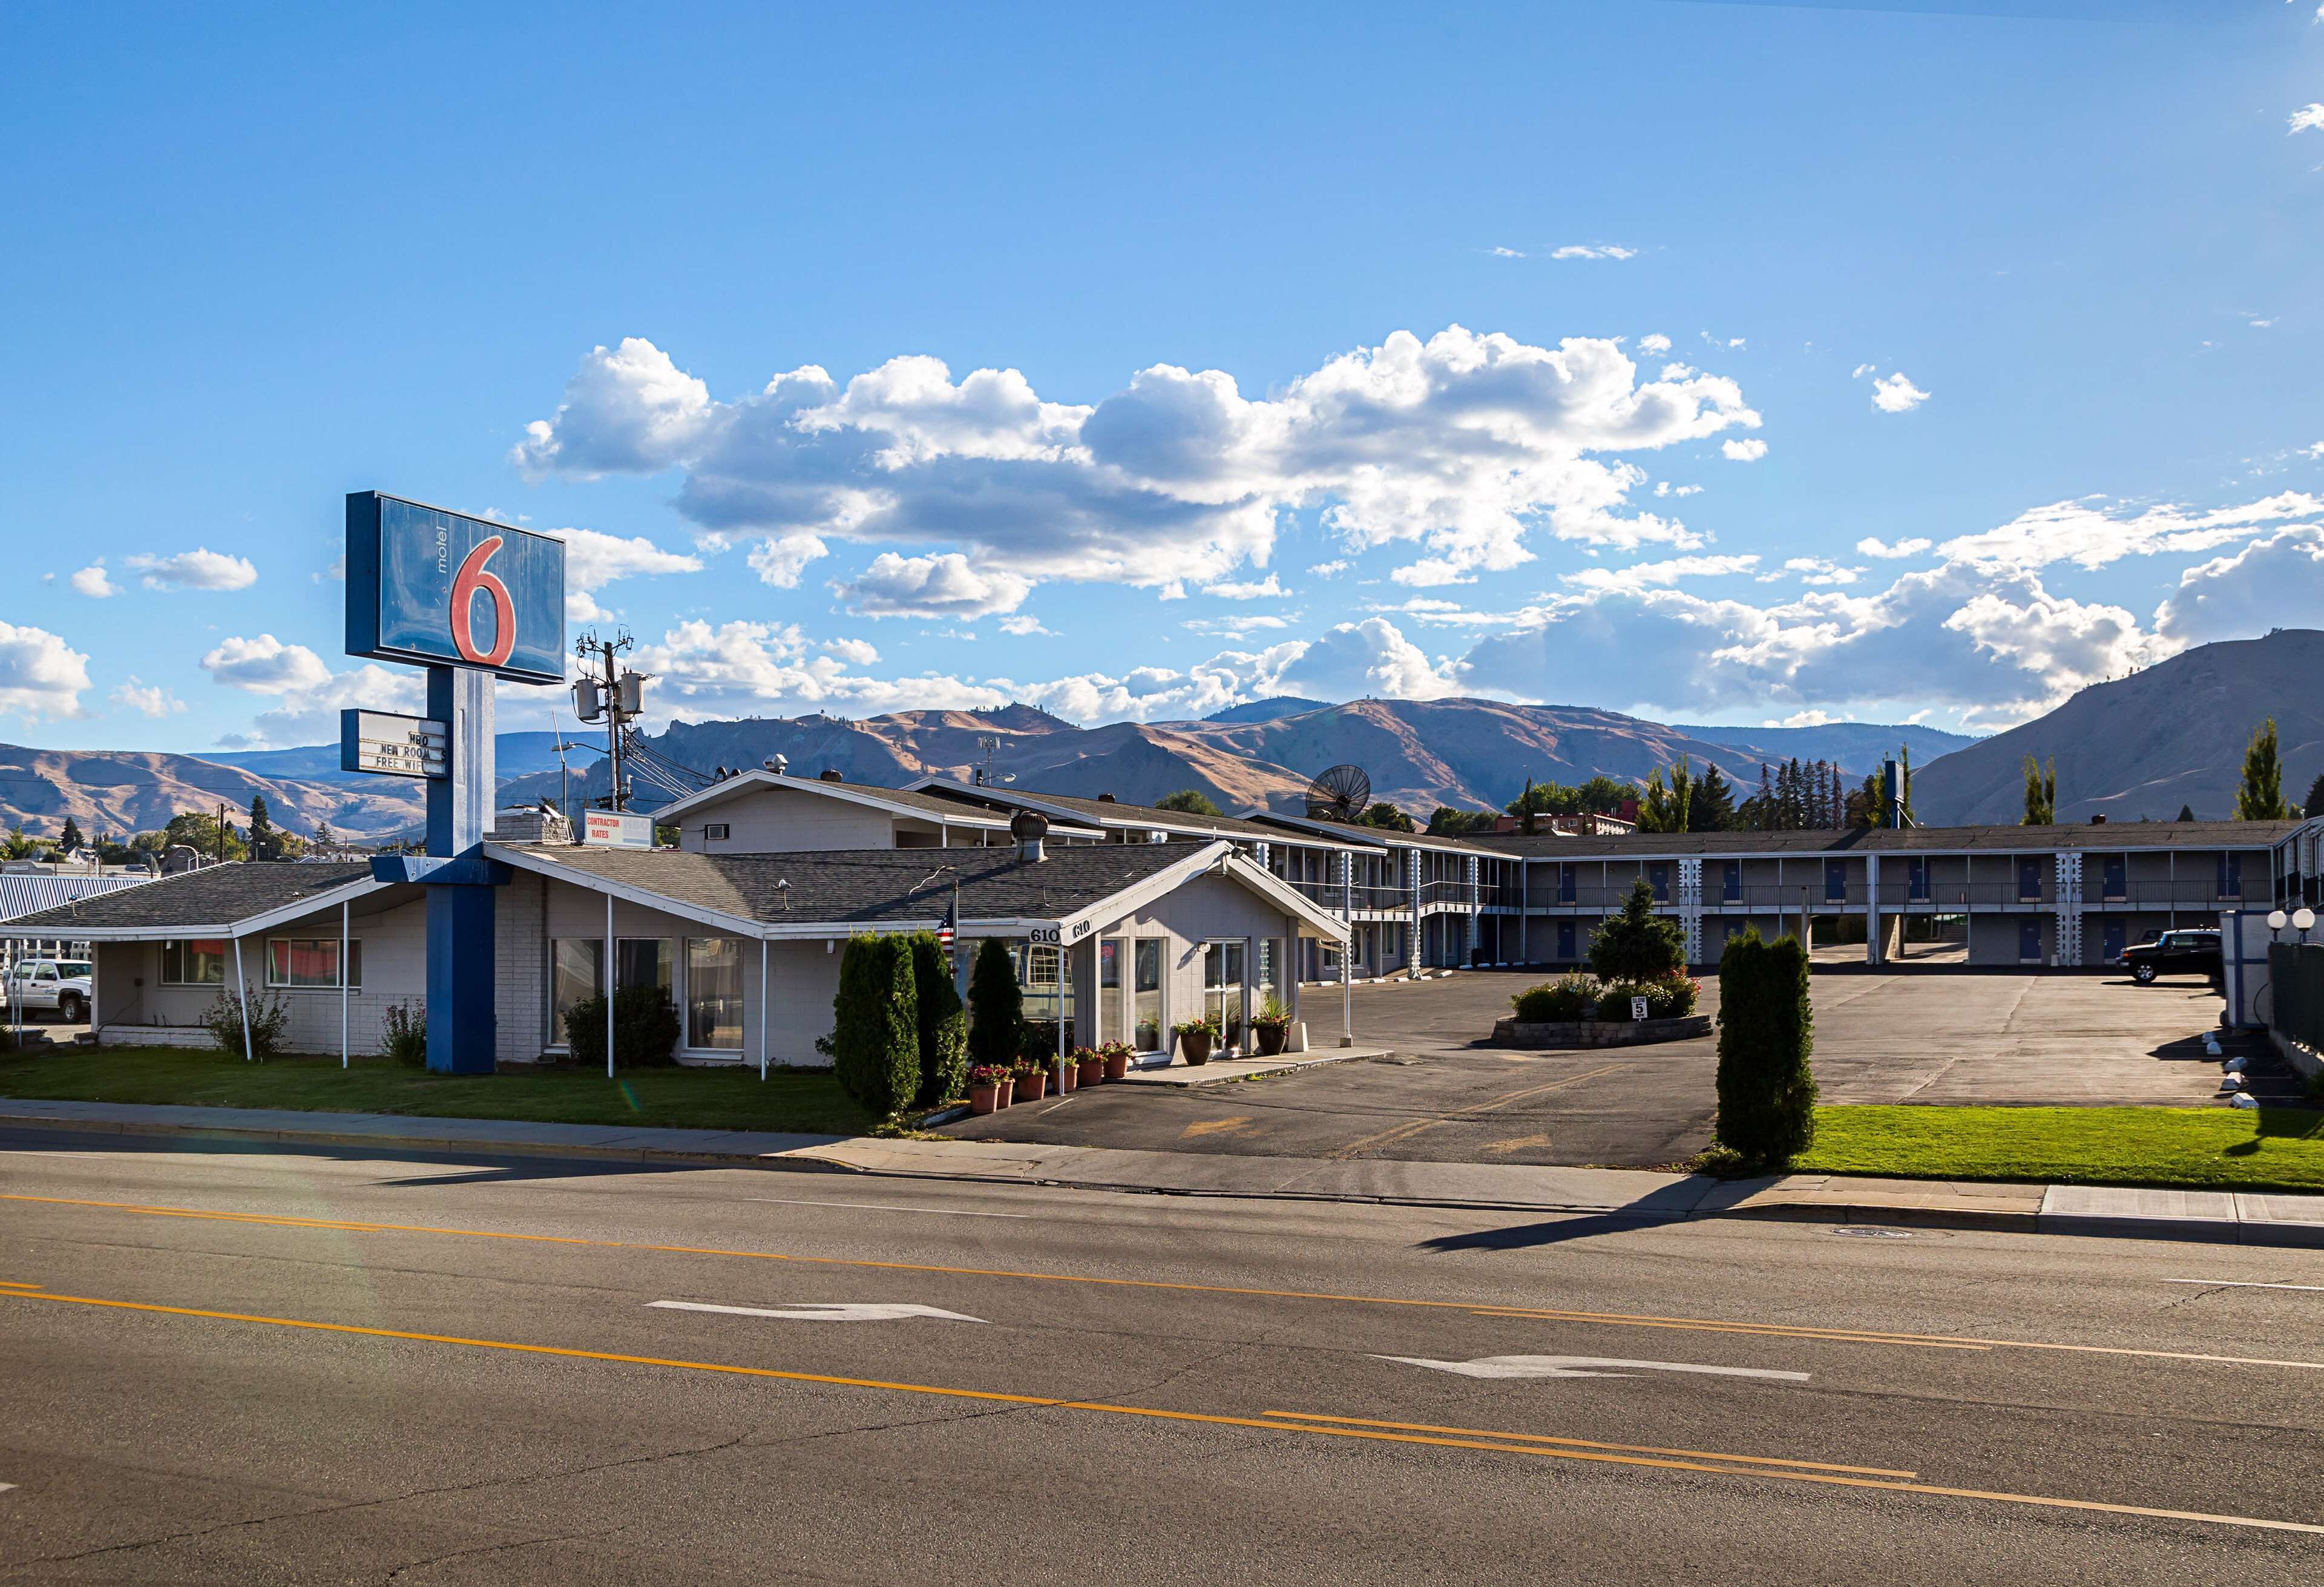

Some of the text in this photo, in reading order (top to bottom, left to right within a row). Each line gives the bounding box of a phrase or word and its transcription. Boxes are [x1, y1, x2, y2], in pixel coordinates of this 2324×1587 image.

[436, 526, 447, 574] motel
[449, 535, 516, 666] 6
[410, 734, 428, 746] HBO
[381, 743, 398, 755] NEW
[376, 757, 424, 772] FREE WIFI
[587, 817, 620, 827] CONTRACTOR
[592, 830, 609, 839] RATES
[1031, 929, 1060, 942] 610
[1073, 920, 1090, 939] 610
[1636, 1004, 1643, 1013] 5
